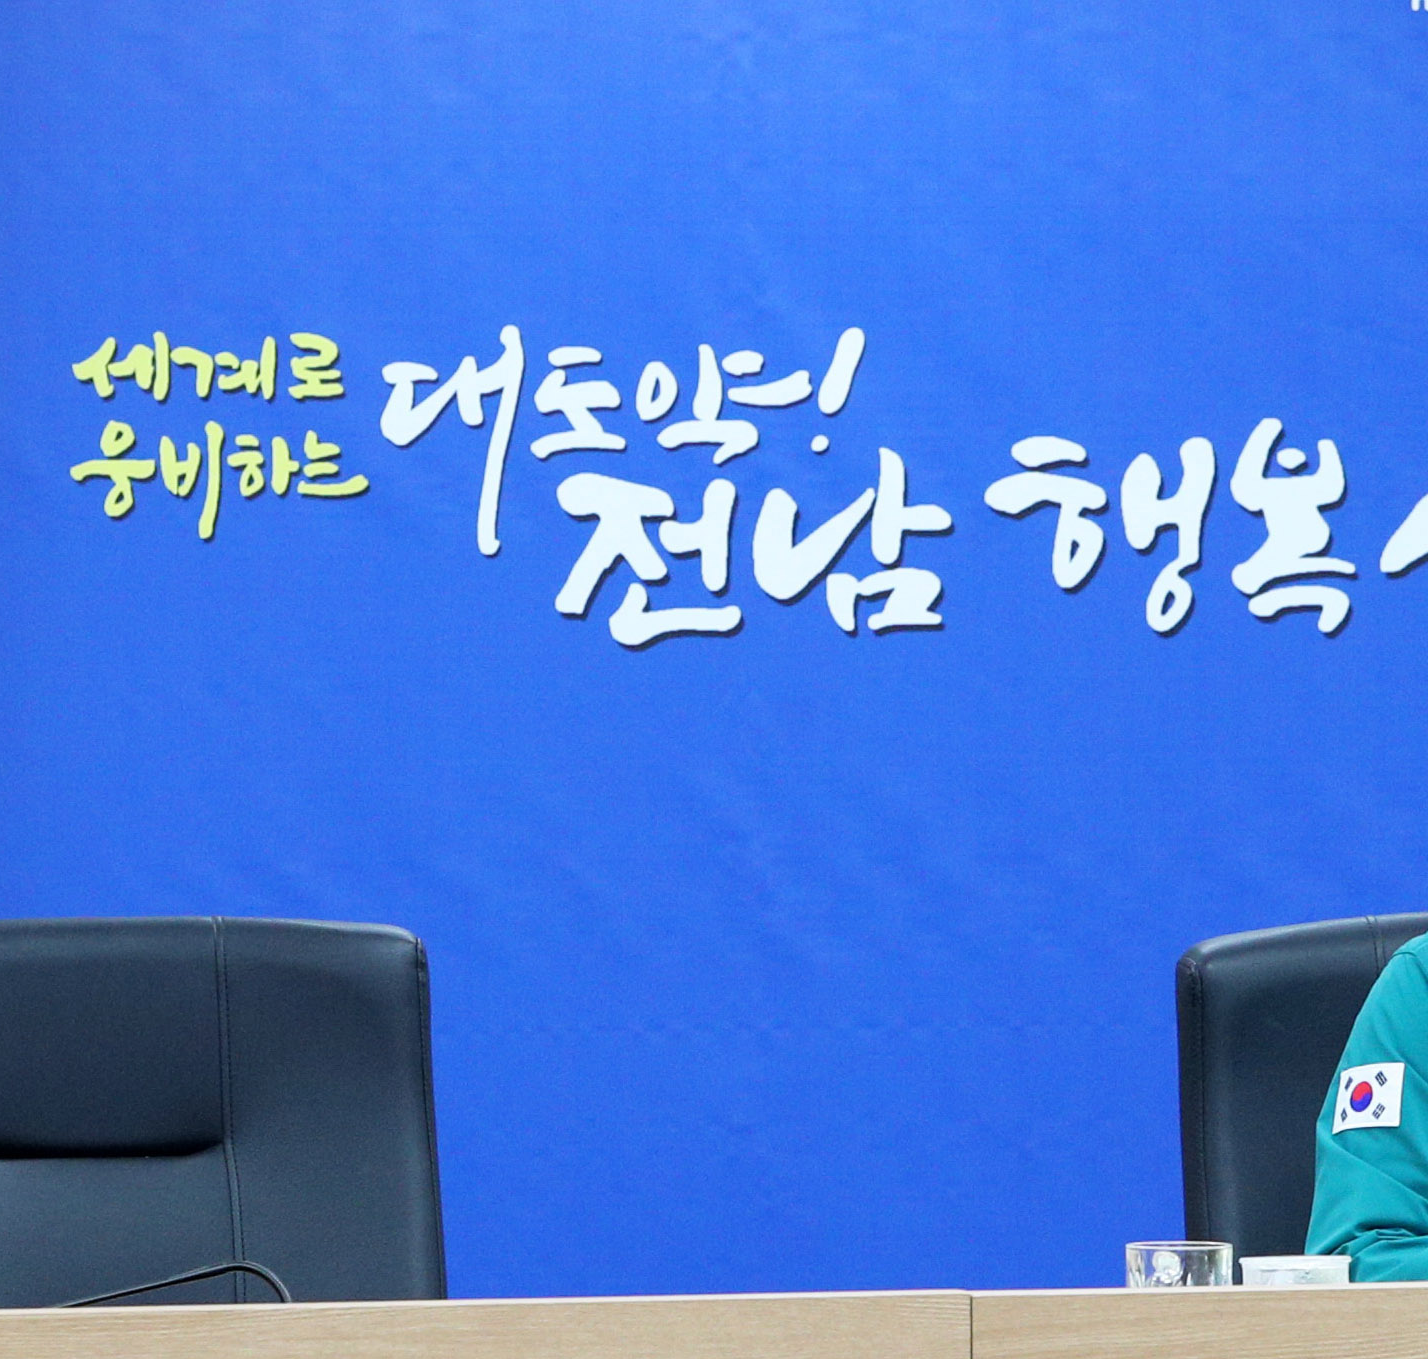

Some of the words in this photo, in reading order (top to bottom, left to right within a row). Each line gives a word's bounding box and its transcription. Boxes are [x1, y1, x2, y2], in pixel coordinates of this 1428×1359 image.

[71, 331, 345, 402] 세계로
[379, 324, 865, 557] 대도약!
[69, 419, 370, 540] 웅비하는
[554, 446, 953, 648] 전남
